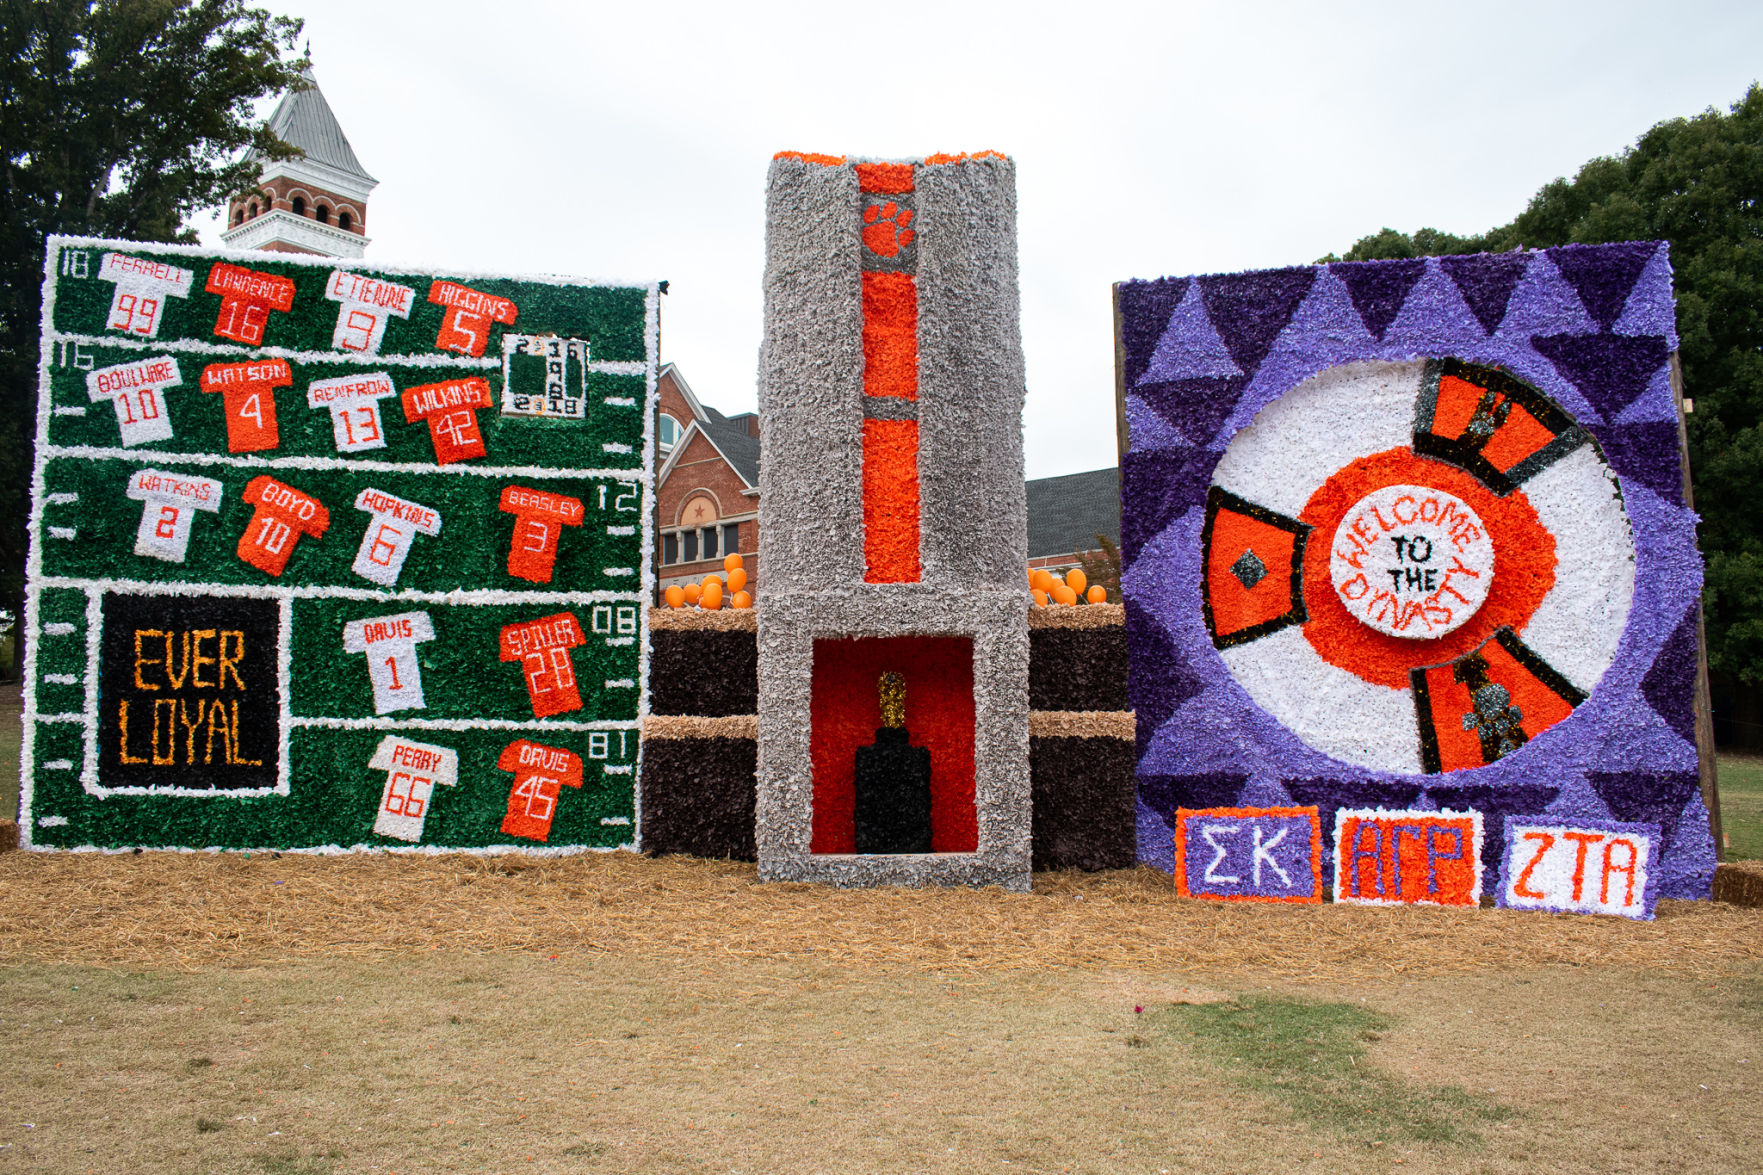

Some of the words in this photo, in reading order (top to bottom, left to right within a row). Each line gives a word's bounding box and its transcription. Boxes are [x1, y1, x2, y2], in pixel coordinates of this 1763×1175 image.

[62, 251, 88, 278] 18
[110, 254, 184, 284] FERRELL
[213, 268, 288, 303] LAWRENCE
[334, 272, 411, 312] ETIENNE
[438, 284, 509, 321] HIGGINS
[114, 294, 157, 334] 99
[221, 301, 260, 341] 16
[342, 311, 376, 351] 9
[450, 310, 479, 353] 5
[97, 361, 174, 394] BOULWARE
[208, 364, 286, 385] WATSON
[313, 380, 390, 403] RENFROW
[118, 389, 159, 424] 10
[239, 393, 263, 428] 4
[412, 382, 481, 413] WILKINS
[339, 407, 379, 445] 13
[437, 411, 477, 446] 42
[139, 474, 211, 501] WATKINS
[261, 482, 315, 521] BOYD
[509, 490, 581, 518] BEASLEY
[598, 481, 637, 511] 12
[155, 506, 179, 539] 2
[362, 491, 435, 529] HOPKINS
[255, 517, 291, 554] 10
[369, 523, 402, 566] 6
[524, 521, 548, 552] 3
[1337, 495, 1481, 569] WELCOME
[1391, 535, 1432, 563] TO
[1339, 556, 1479, 632] DYNASTY
[1388, 568, 1438, 594] THE
[364, 619, 412, 645] DAVIS
[592, 606, 637, 634] 08
[508, 619, 576, 657] SPILLER
[134, 628, 247, 691] EVER
[385, 656, 403, 690] 1
[525, 646, 574, 694] 28
[119, 698, 262, 766] LOYAL
[588, 732, 627, 759] 81
[392, 744, 442, 772] PERRY
[519, 744, 570, 774] DAVIS
[385, 771, 431, 818] 66
[515, 775, 559, 820] 45
